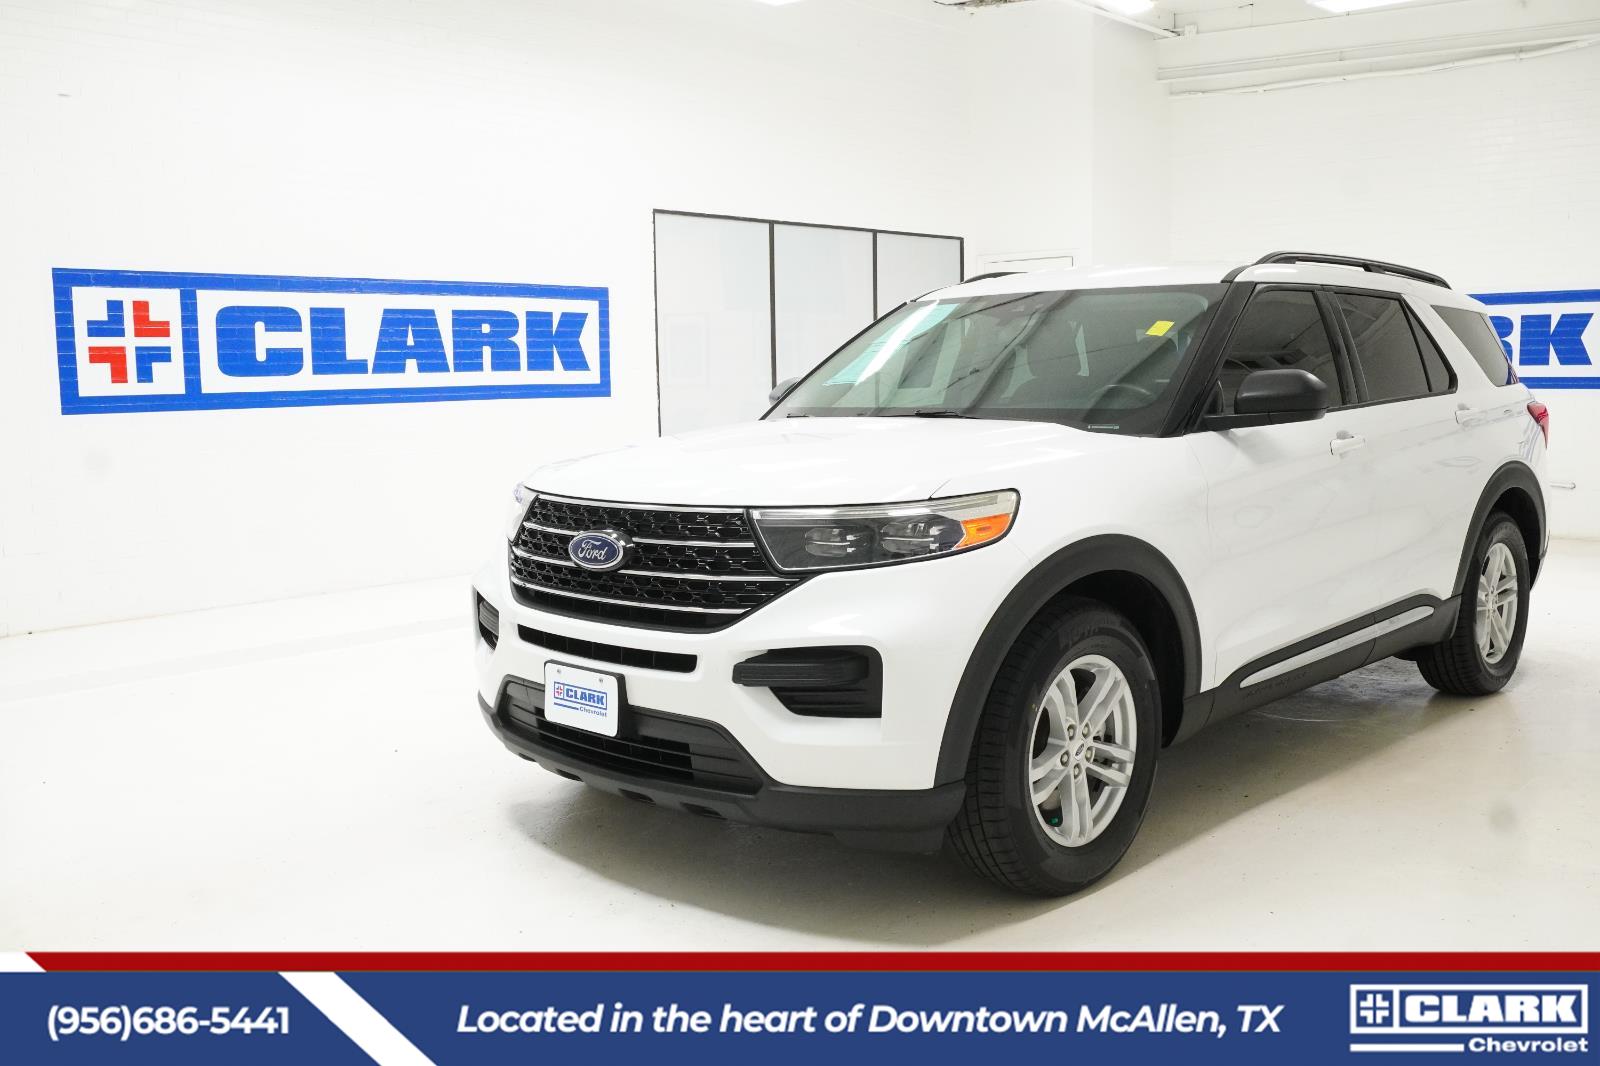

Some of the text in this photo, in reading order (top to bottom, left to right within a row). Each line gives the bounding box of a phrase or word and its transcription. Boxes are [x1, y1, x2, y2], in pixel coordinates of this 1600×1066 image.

[215, 305, 591, 377] CLARK
[577, 539, 609, 561] Ford
[565, 687, 605, 706] CLARK
[579, 706, 607, 718] Chevrolet
